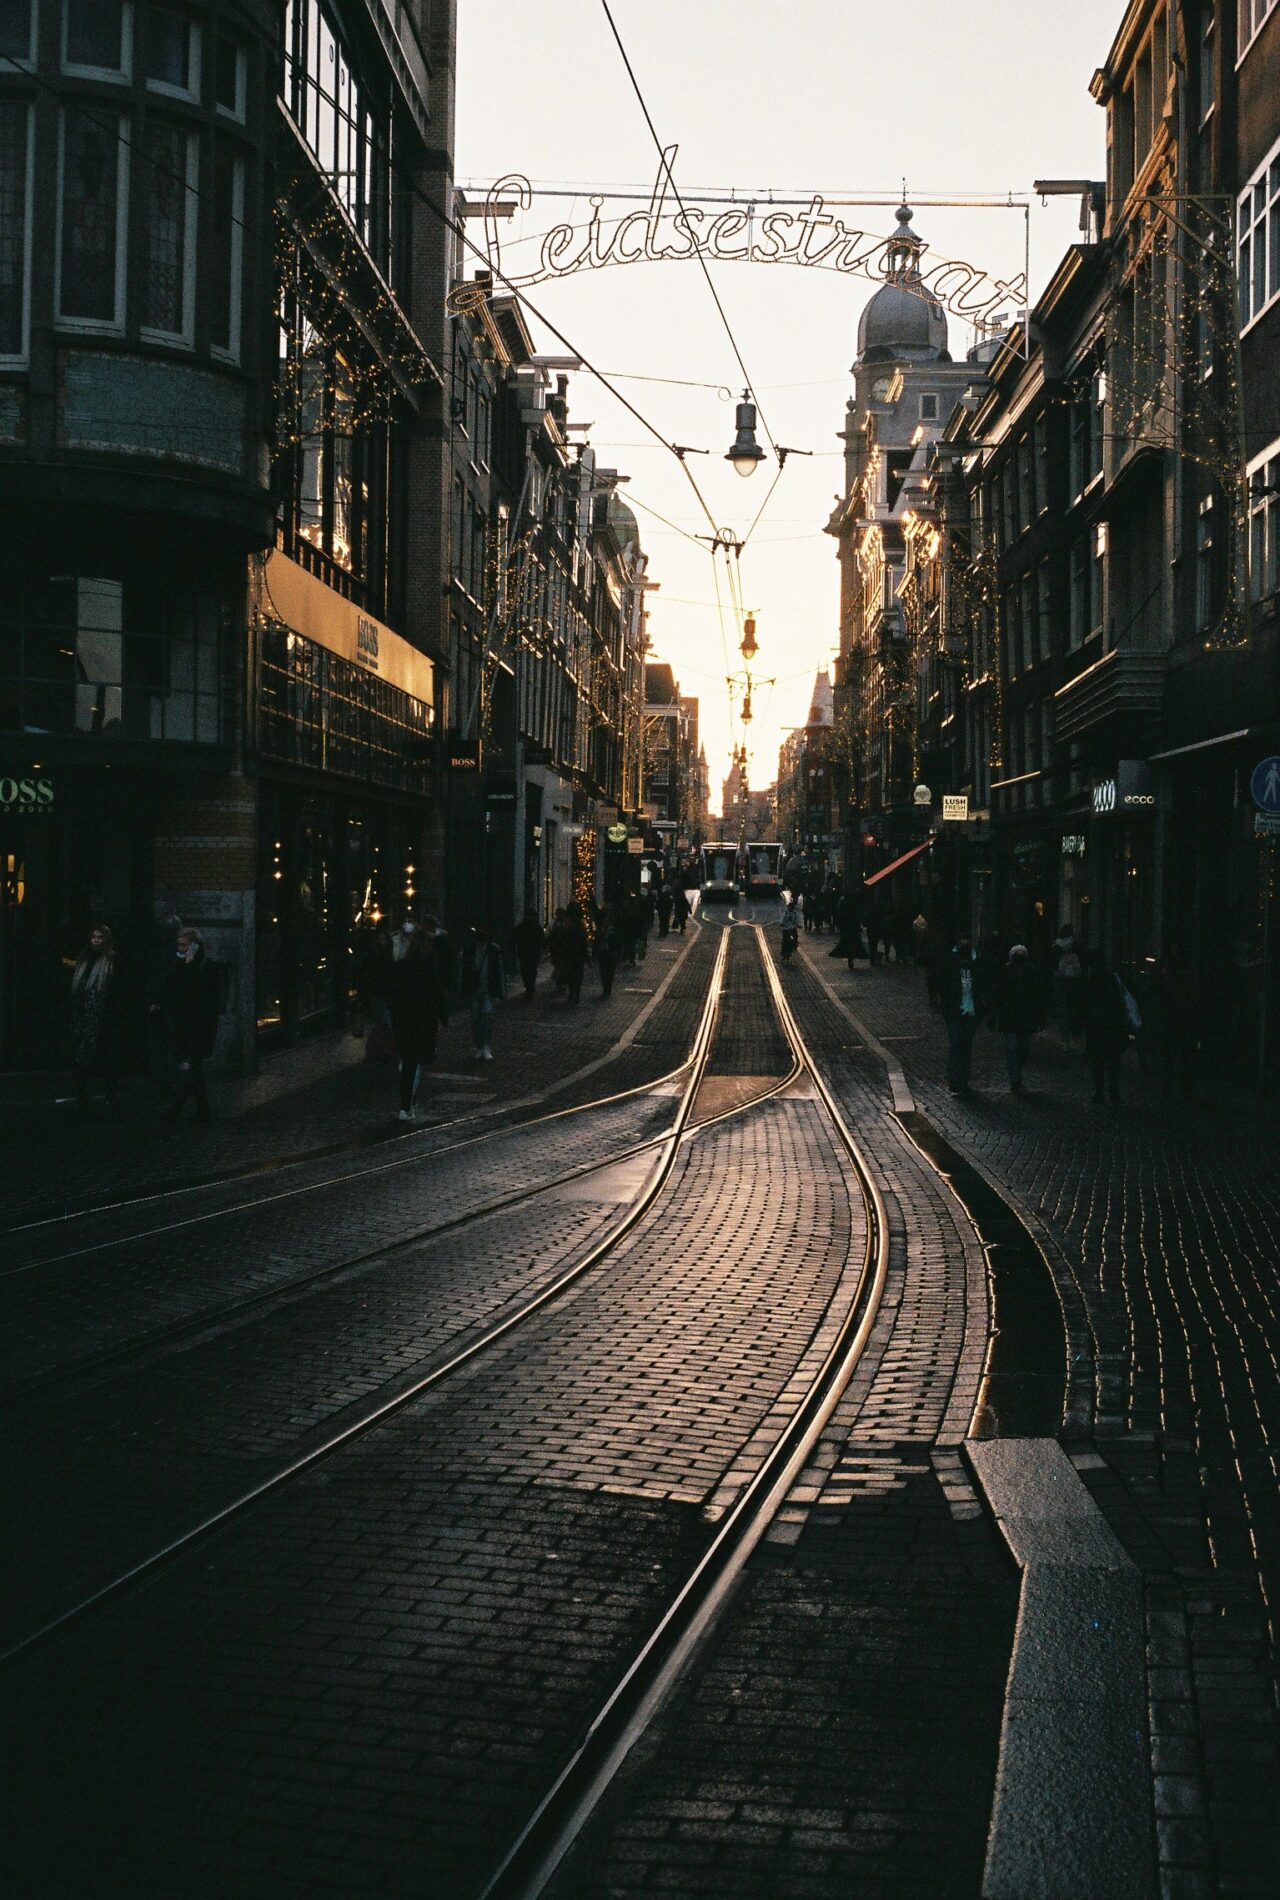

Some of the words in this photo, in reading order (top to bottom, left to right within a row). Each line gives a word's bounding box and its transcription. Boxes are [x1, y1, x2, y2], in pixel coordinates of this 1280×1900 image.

[445, 143, 1027, 331] Leidsestraat
[451, 758, 476, 766] BOSS
[1124, 795, 1155, 804] ecco
